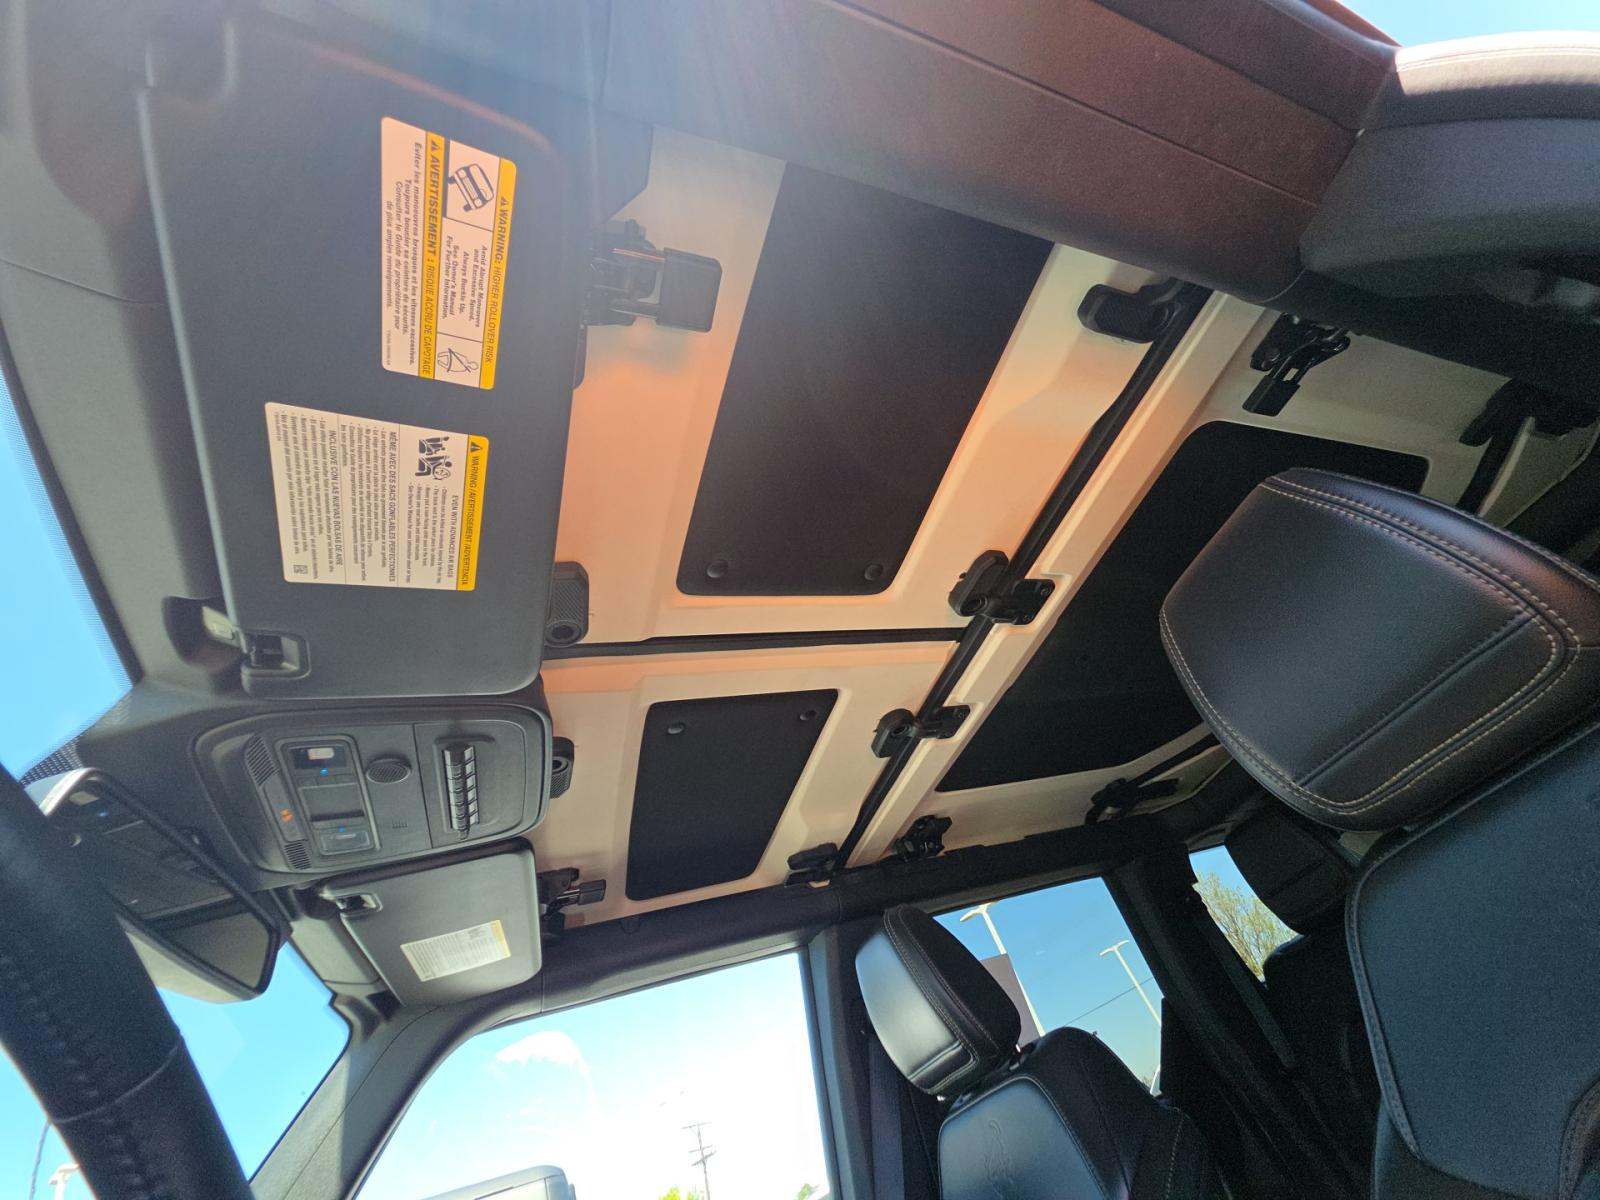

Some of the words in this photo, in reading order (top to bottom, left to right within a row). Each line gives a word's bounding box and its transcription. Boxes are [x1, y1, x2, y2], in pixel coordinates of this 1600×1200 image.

[395, 180, 403, 222] Consulter
[427, 154, 440, 256] AVERTISSEMENT
[395, 223, 402, 232] le
[494, 207, 507, 264] WARNING:
[394, 233, 402, 256] Guide
[394, 258, 401, 269] du
[450, 260, 458, 289] Owner's
[461, 250, 469, 276] Always
[425, 264, 434, 295] RISQUE
[459, 278, 467, 301] Buckle
[470, 264, 478, 297] Excessive
[491, 265, 501, 298] HIGHER
[424, 295, 433, 323] ACCRU
[486, 300, 498, 343] ROLLOVER
[424, 324, 432, 334] DE
[422, 335, 432, 375] CAPOTAGE
[485, 345, 493, 363] RISK
[328, 429, 337, 465] INCLUSIVE
[330, 466, 338, 480] CON
[469, 455, 479, 488] WARNING
[332, 495, 340, 519] NUEVAS
[388, 501, 396, 539] GONFLABLES
[333, 520, 341, 543] BOLSAS
[448, 525, 456, 554] ADVANCED
